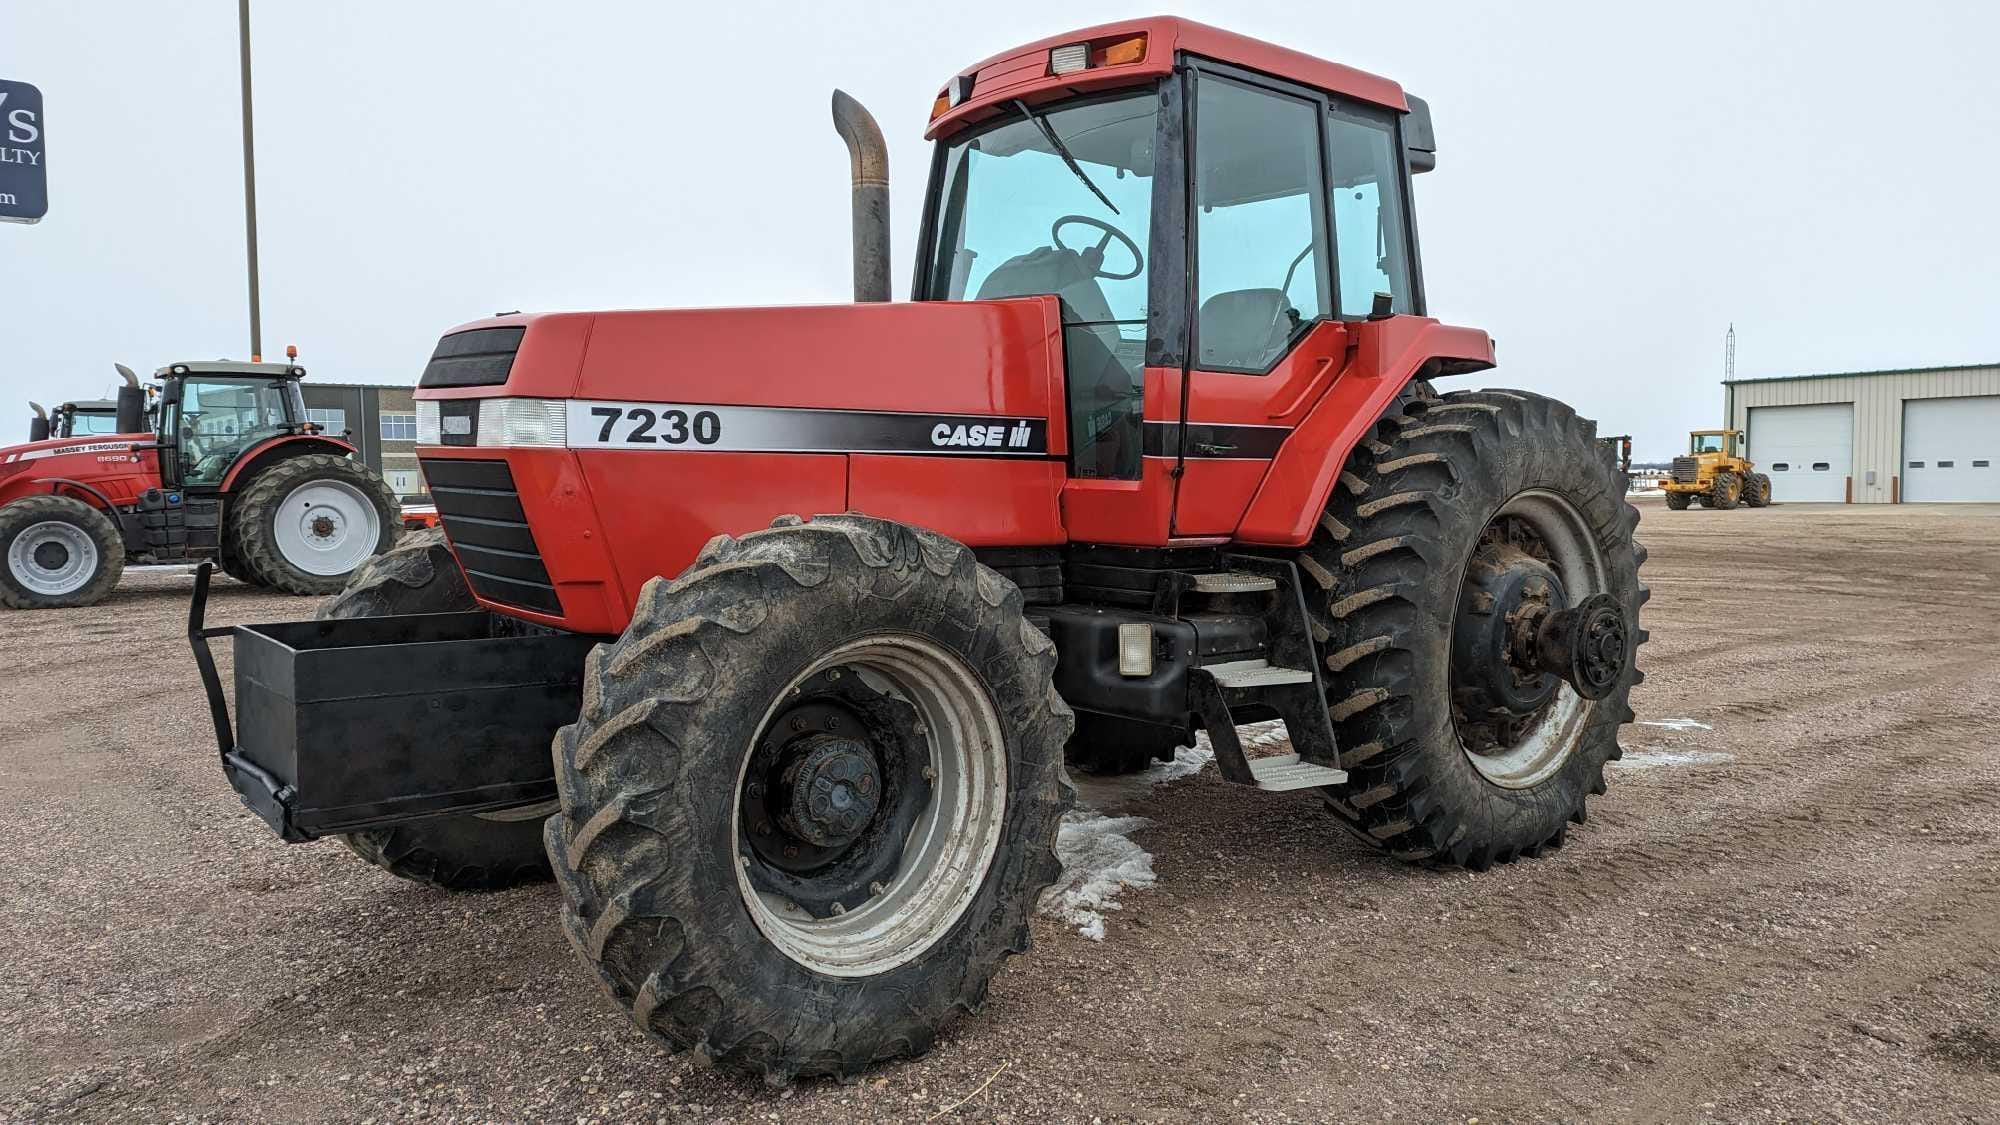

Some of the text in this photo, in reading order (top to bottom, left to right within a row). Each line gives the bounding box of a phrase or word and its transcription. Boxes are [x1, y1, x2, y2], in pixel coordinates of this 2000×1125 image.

[591, 407, 721, 445] 7230
[931, 423, 1005, 447] CASE
[53, 443, 128, 454] MASSEY FERGUSON
